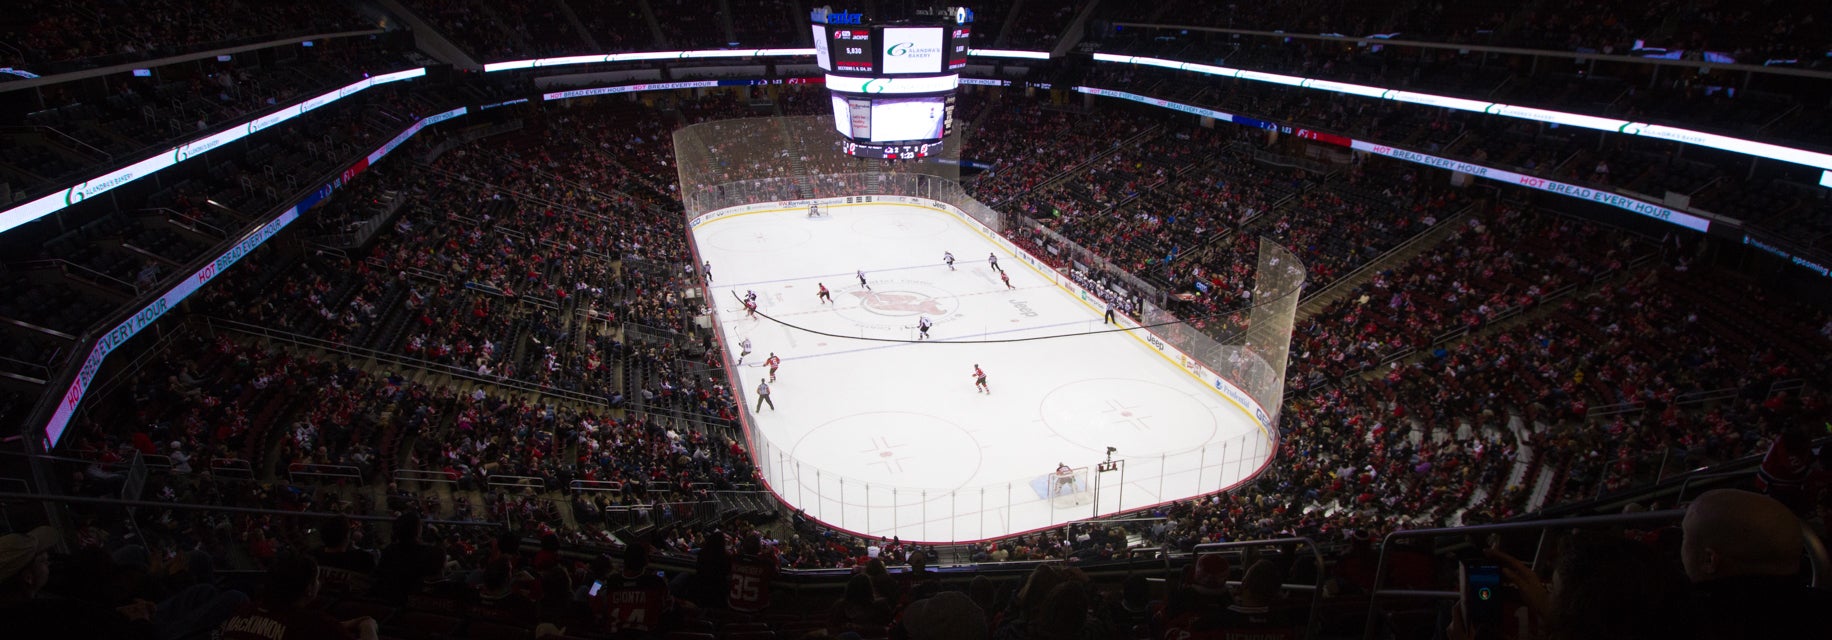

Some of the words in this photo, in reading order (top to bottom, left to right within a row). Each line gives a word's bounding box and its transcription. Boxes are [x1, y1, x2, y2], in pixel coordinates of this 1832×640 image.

[585, 88, 606, 96] EVERY
[1101, 89, 1118, 97] BREAD
[1167, 102, 1183, 111] BREAD
[1183, 105, 1200, 113] EVERY
[1200, 108, 1214, 116] HOUR
[900, 151, 914, 159] 1:23
[1372, 145, 1391, 155] HOT
[1392, 149, 1422, 162] BREAD
[1424, 156, 1455, 170] EVERY
[1457, 163, 1488, 176] HOUR
[932, 201, 947, 210] Jeep
[1520, 176, 1546, 188] HOT
[1548, 182, 1590, 199] BREAD
[1593, 192, 1634, 210] EVERY
[1634, 202, 1672, 220] HOUR
[198, 264, 216, 284] HOT
[216, 247, 242, 272] BREAD
[242, 232, 263, 252] EVERY
[264, 218, 282, 238] HOUR
[1009, 300, 1038, 317] Jeep
[1146, 333, 1164, 351] Jeep
[66, 378, 83, 412] HOT
[98, 318, 134, 356] EVERY
[137, 298, 168, 328] HOUR
[1223, 384, 1250, 408] Prudential
[612, 591, 646, 604] GIONTA
[730, 574, 760, 602] 35
[224, 615, 286, 640] MACKINNON
[610, 608, 648, 632] 14
